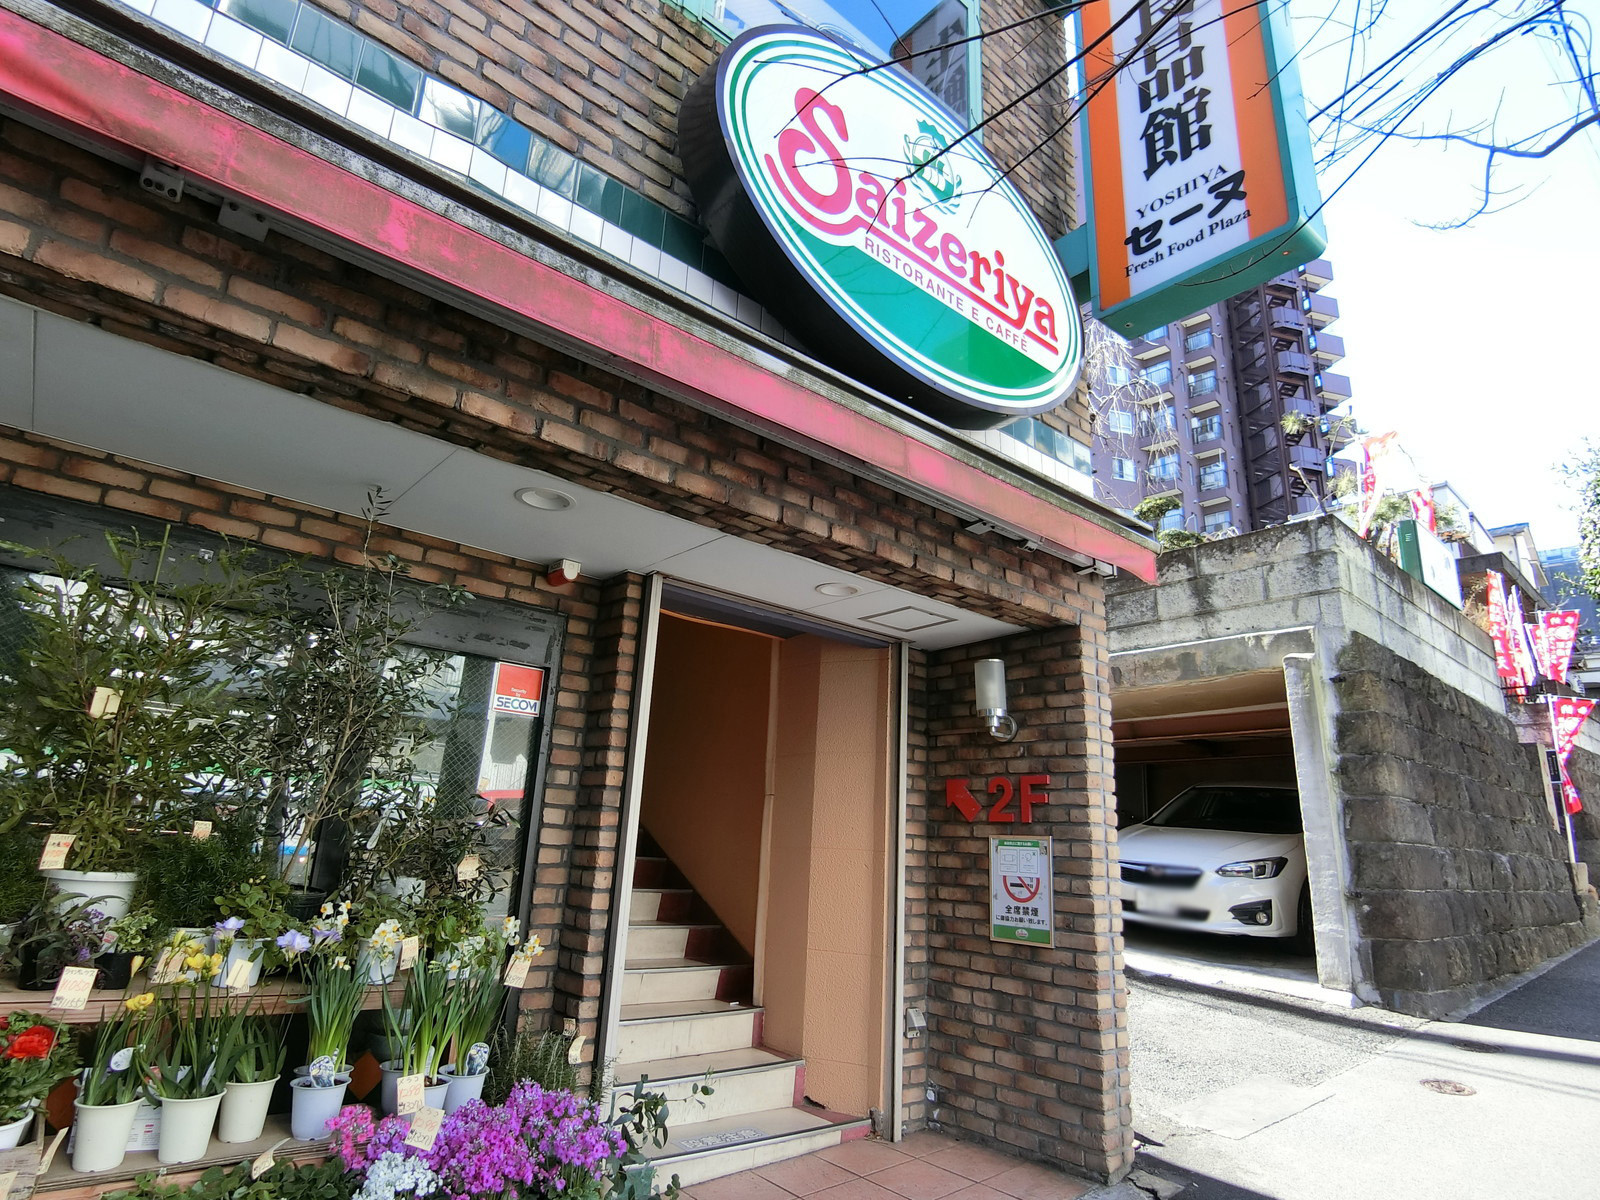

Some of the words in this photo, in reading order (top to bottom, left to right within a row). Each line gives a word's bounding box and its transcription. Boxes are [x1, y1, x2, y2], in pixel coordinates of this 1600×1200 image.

[764, 87, 1059, 345] Saizeriya
[1124, 170, 1248, 256] セーヌ
[1136, 164, 1229, 220] YOSHIYA
[1124, 250, 1165, 279] Fresh
[1167, 228, 1205, 259] Food
[1208, 208, 1252, 238] Plaza
[864, 236, 964, 311] RISTORANTE
[971, 306, 980, 322] E
[985, 316, 1029, 353] CAFFÈ
[496, 696, 538, 712] SECOM
[987, 774, 1051, 824] 2F
[1004, 904, 1040, 917] 全席禁煙
